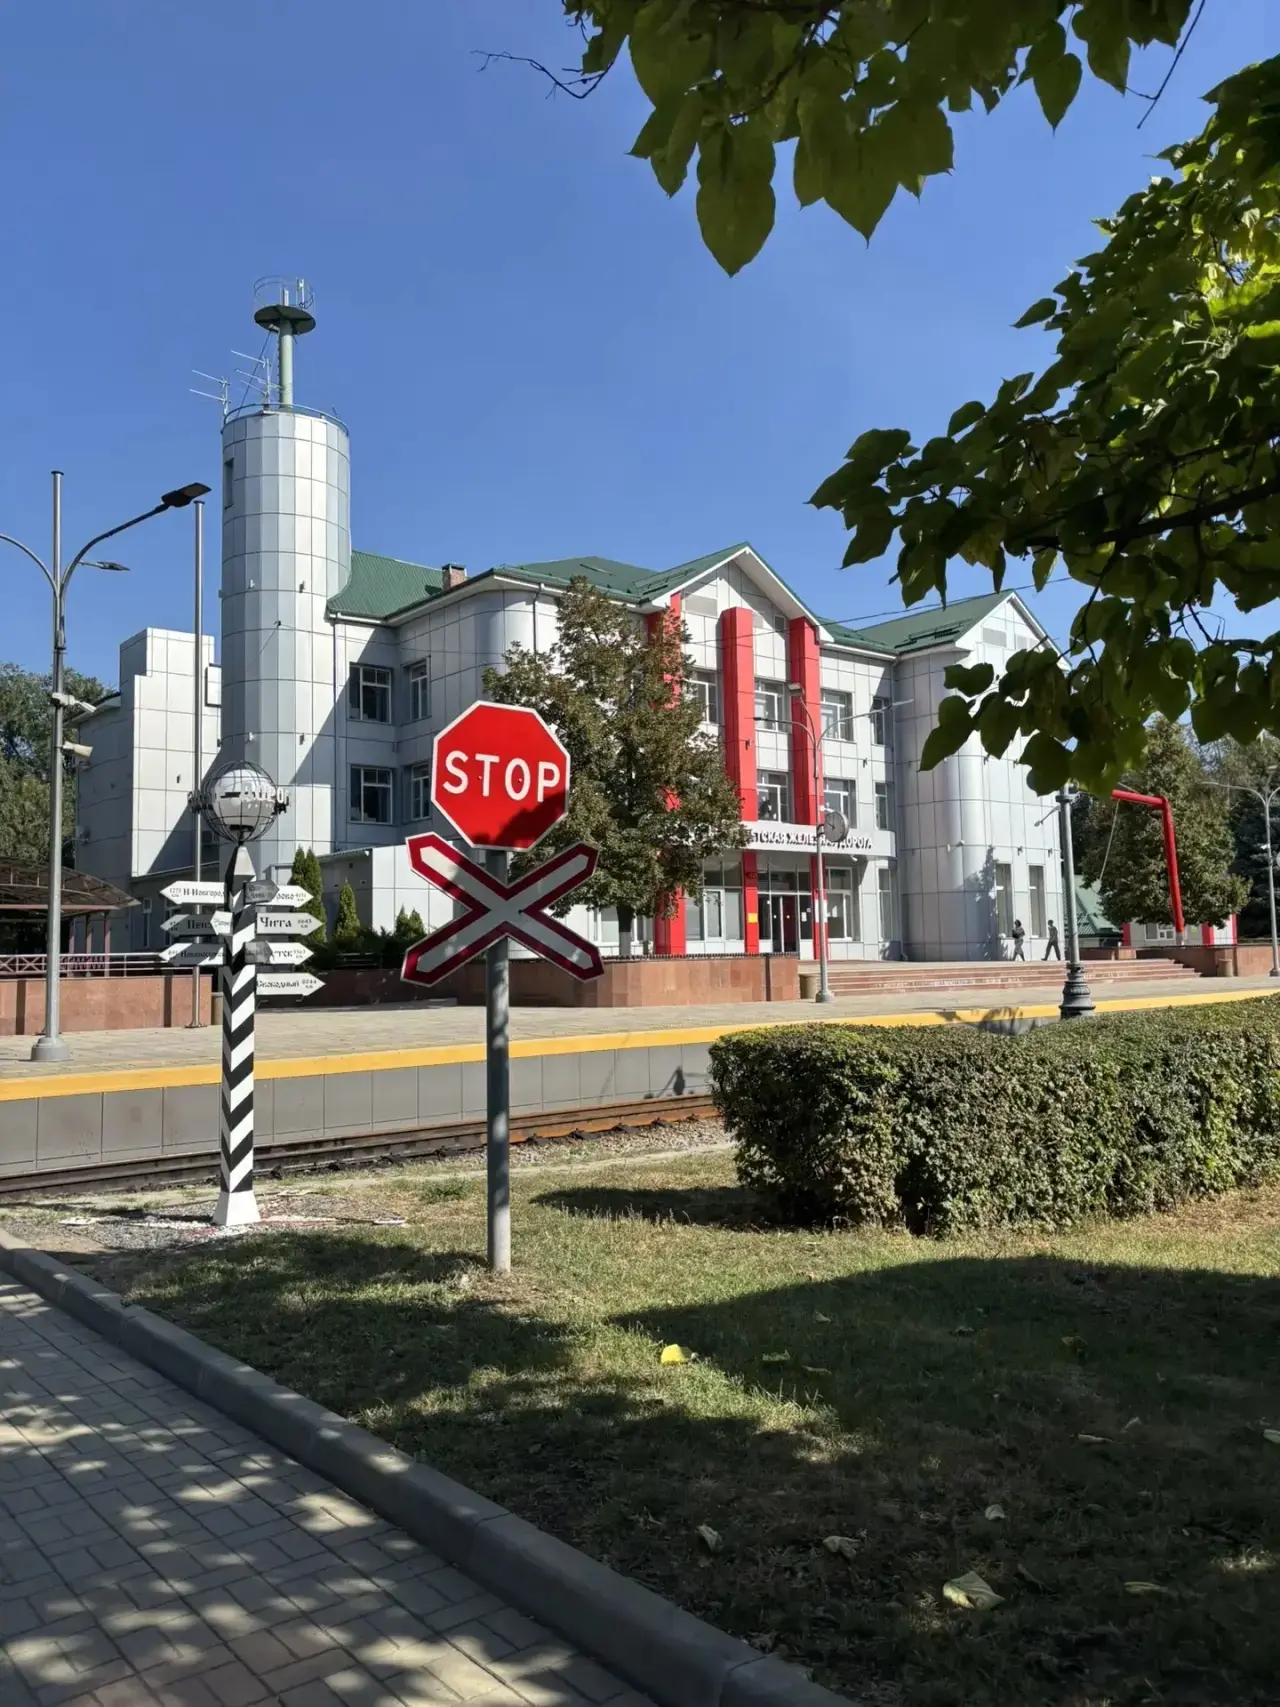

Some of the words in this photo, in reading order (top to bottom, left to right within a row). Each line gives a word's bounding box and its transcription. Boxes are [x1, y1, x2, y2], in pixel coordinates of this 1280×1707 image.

[443, 750, 560, 802] STOP
[749, 830, 786, 844] ЕТСКАЯ
[260, 916, 292, 927] Чита
